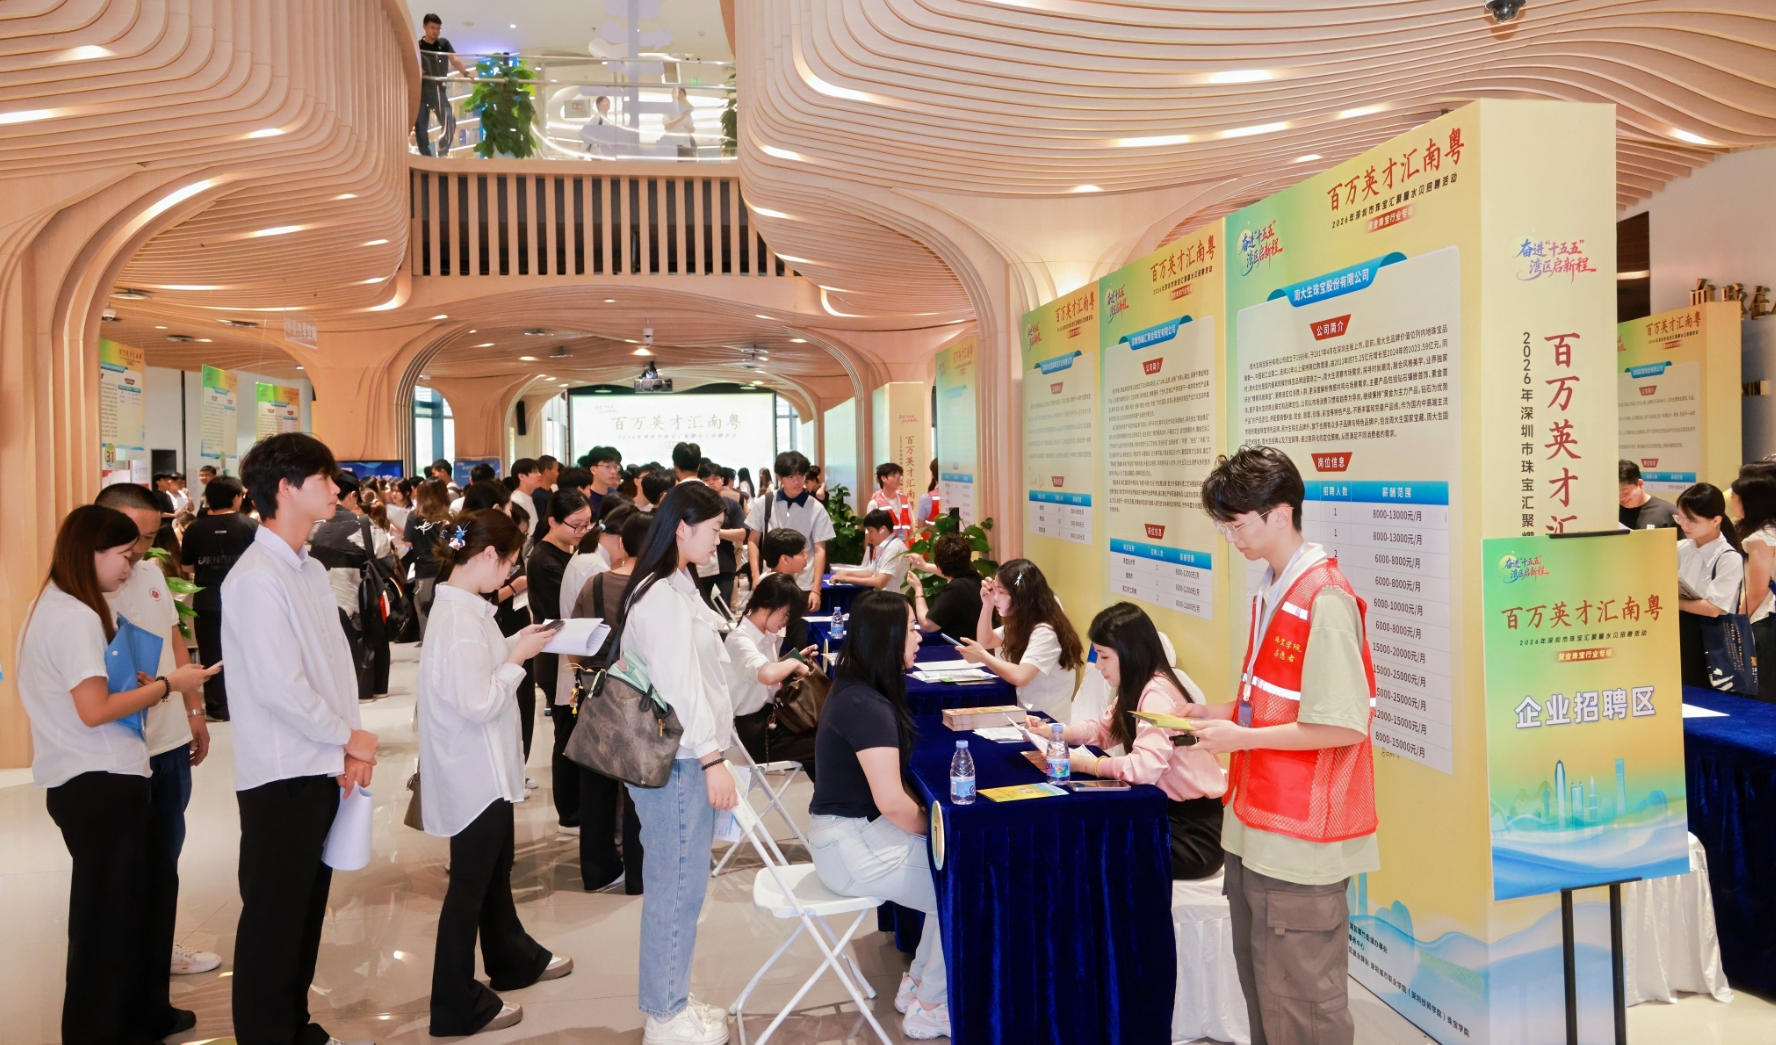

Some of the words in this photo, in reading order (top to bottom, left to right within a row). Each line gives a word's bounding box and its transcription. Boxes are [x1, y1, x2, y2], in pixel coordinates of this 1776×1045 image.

[1327, 128, 1464, 211] 百万英才汇南粤
[1150, 234, 1215, 282] 百万英才汇南粤
[1518, 256, 1596, 283] 湾区启新程
[1294, 268, 1370, 301] 周大生珠宝股份有限公司
[1316, 320, 1344, 337] 公司简介
[1646, 311, 1701, 336] 百万英才汇南粤
[611, 414, 740, 430] 百万英才汇南粤
[1317, 456, 1345, 468] 岗位信息
[1323, 486, 1348, 496] 招聘人数
[1382, 487, 1412, 498] 薪酬范围
[1501, 594, 1663, 630] 百万英才汇南粤
[1376, 688, 1427, 711] 5000-25000元/月
[1515, 686, 1657, 729] 企业招聘区
